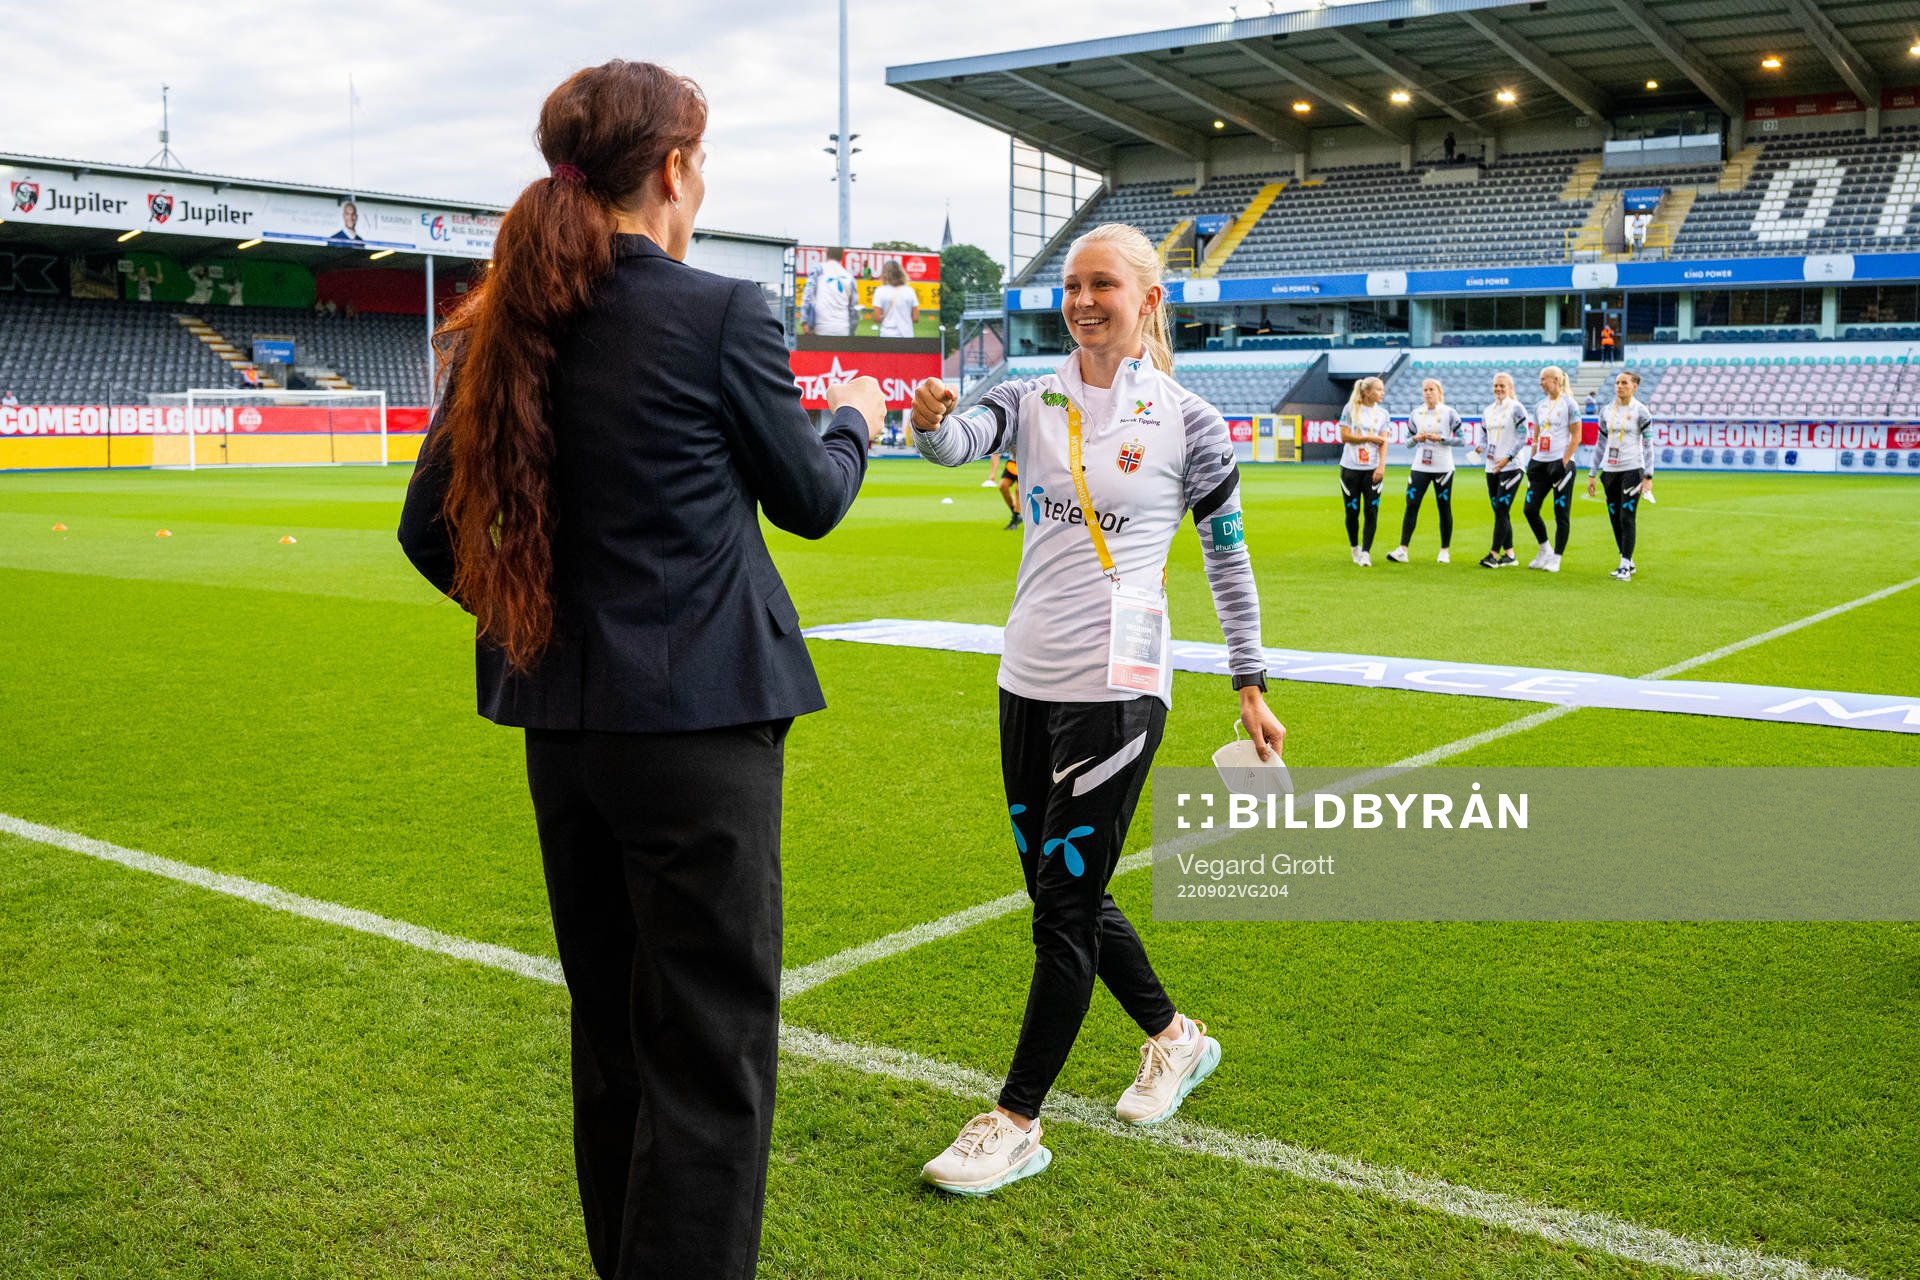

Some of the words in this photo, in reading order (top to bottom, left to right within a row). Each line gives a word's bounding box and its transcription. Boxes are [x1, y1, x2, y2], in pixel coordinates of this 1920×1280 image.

[45, 189, 128, 215] Jupiler
[178, 201, 253, 226] Jupiler
[1705, 269, 1732, 278] POWER
[1485, 277, 1509, 286] POWER
[1138, 417, 1160, 427] Tipping
